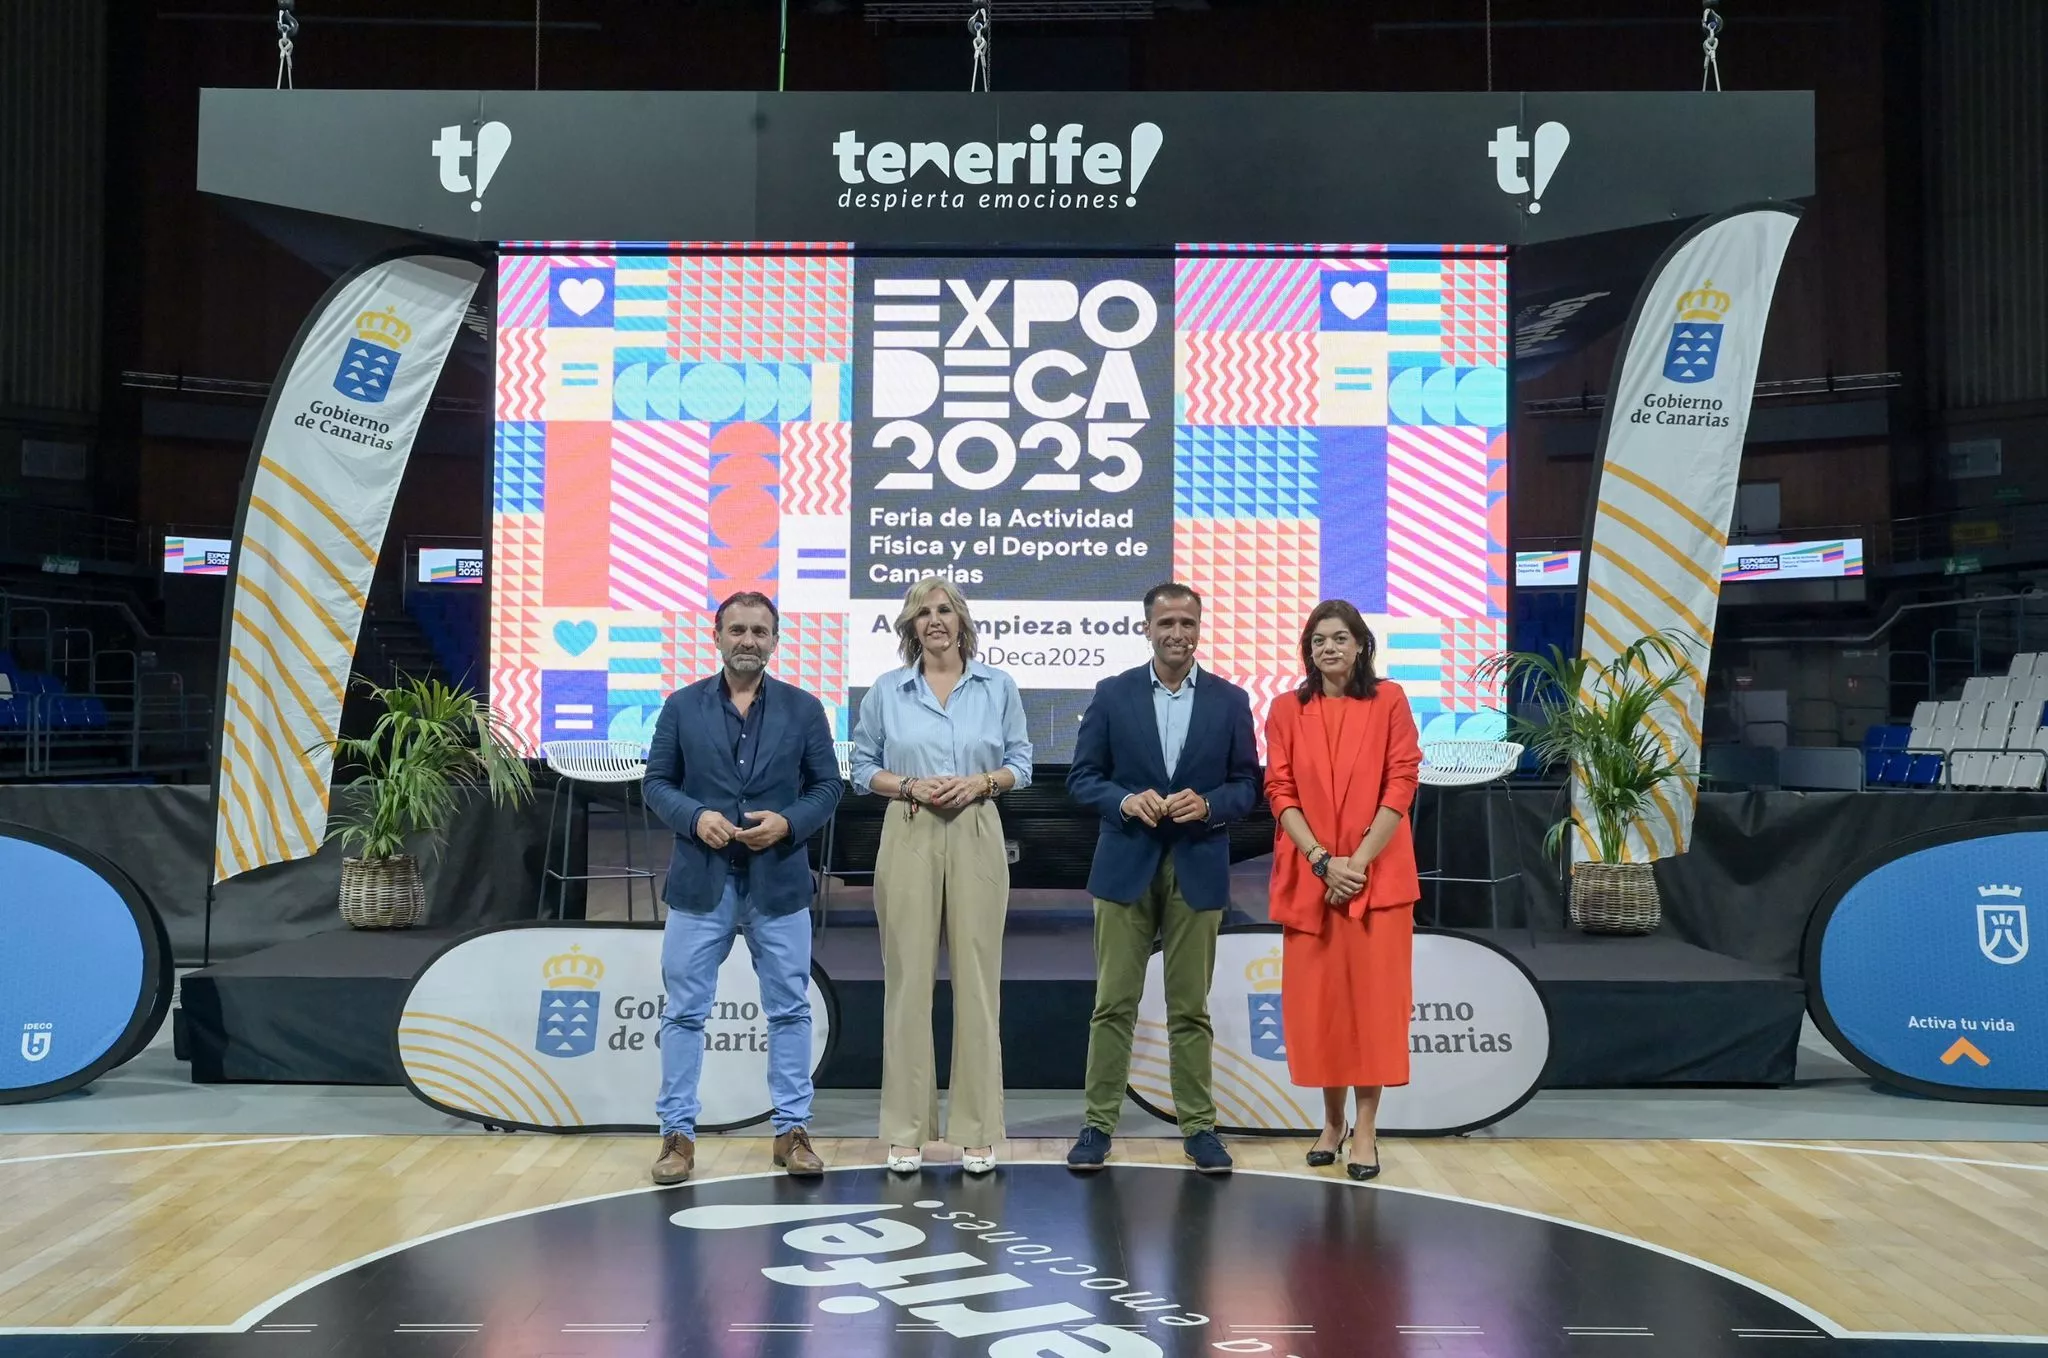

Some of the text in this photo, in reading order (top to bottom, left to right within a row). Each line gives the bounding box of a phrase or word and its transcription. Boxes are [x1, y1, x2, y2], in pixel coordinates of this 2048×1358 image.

[432, 121, 512, 212] t!
[833, 122, 1164, 208] tenerife!
[1488, 121, 1570, 214] t!
[838, 188, 965, 212] despierta
[873, 279, 1158, 349] EXPO
[872, 349, 1151, 419] DECA
[1643, 393, 1723, 411] Gobierno
[309, 400, 390, 434] Gobierno
[1630, 409, 1730, 428] de Canarias
[294, 412, 394, 451] de Canarias
[872, 420, 1144, 493] 2025
[870, 507, 1134, 528] Feria de la Actividad
[870, 535, 1149, 561] Física y el Deporte de
[458, 561, 483, 569] EXPO
[869, 563, 984, 585] Canarias
[973, 615, 1145, 640] mpieza todo
[24, 1022, 53, 1030] IDECO
[1908, 1016, 2016, 1032] Activa tu vida
[608, 1025, 645, 1051] de
[1409, 1026, 1513, 1053] narias
